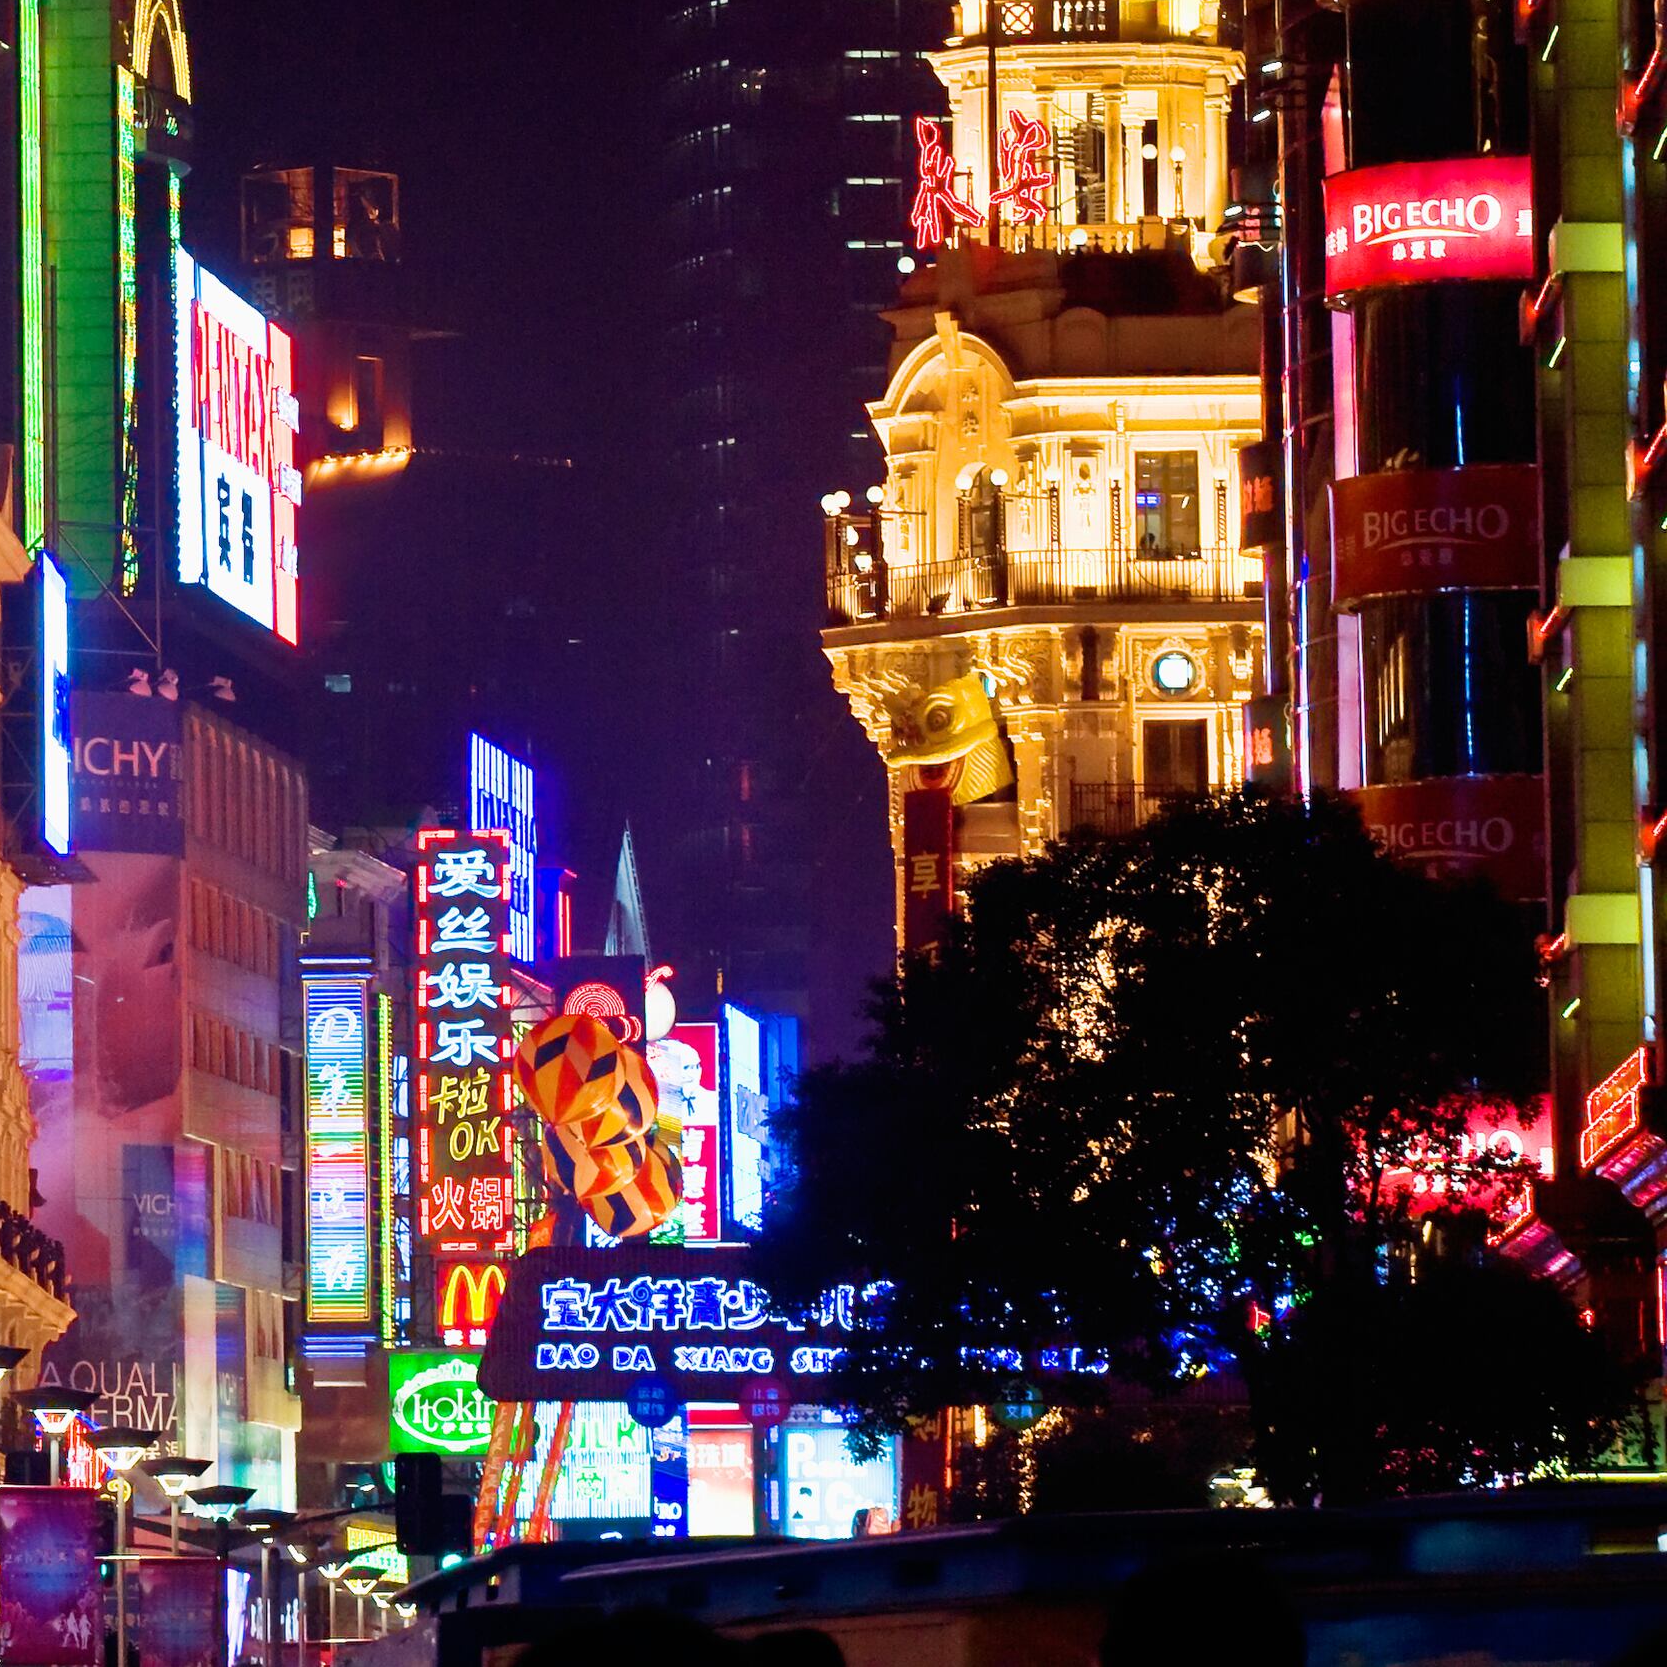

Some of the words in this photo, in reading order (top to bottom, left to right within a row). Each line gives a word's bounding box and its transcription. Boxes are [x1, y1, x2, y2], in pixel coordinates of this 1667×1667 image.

[1353, 200, 1402, 243] BIG
[1406, 193, 1502, 229] ECHO
[1362, 509, 1408, 549] BIG
[1414, 504, 1510, 540] ECHO
[74, 737, 167, 778] ICHY
[1422, 817, 1514, 852] ECHO
[427, 850, 502, 1066] 爱丝娱乐
[431, 1177, 504, 1231] 火锅
[537, 1344, 599, 1371] BAO
[613, 1345, 656, 1371] DA
[675, 1346, 774, 1373] XIANG
[89, 1394, 179, 1431] ERMA
